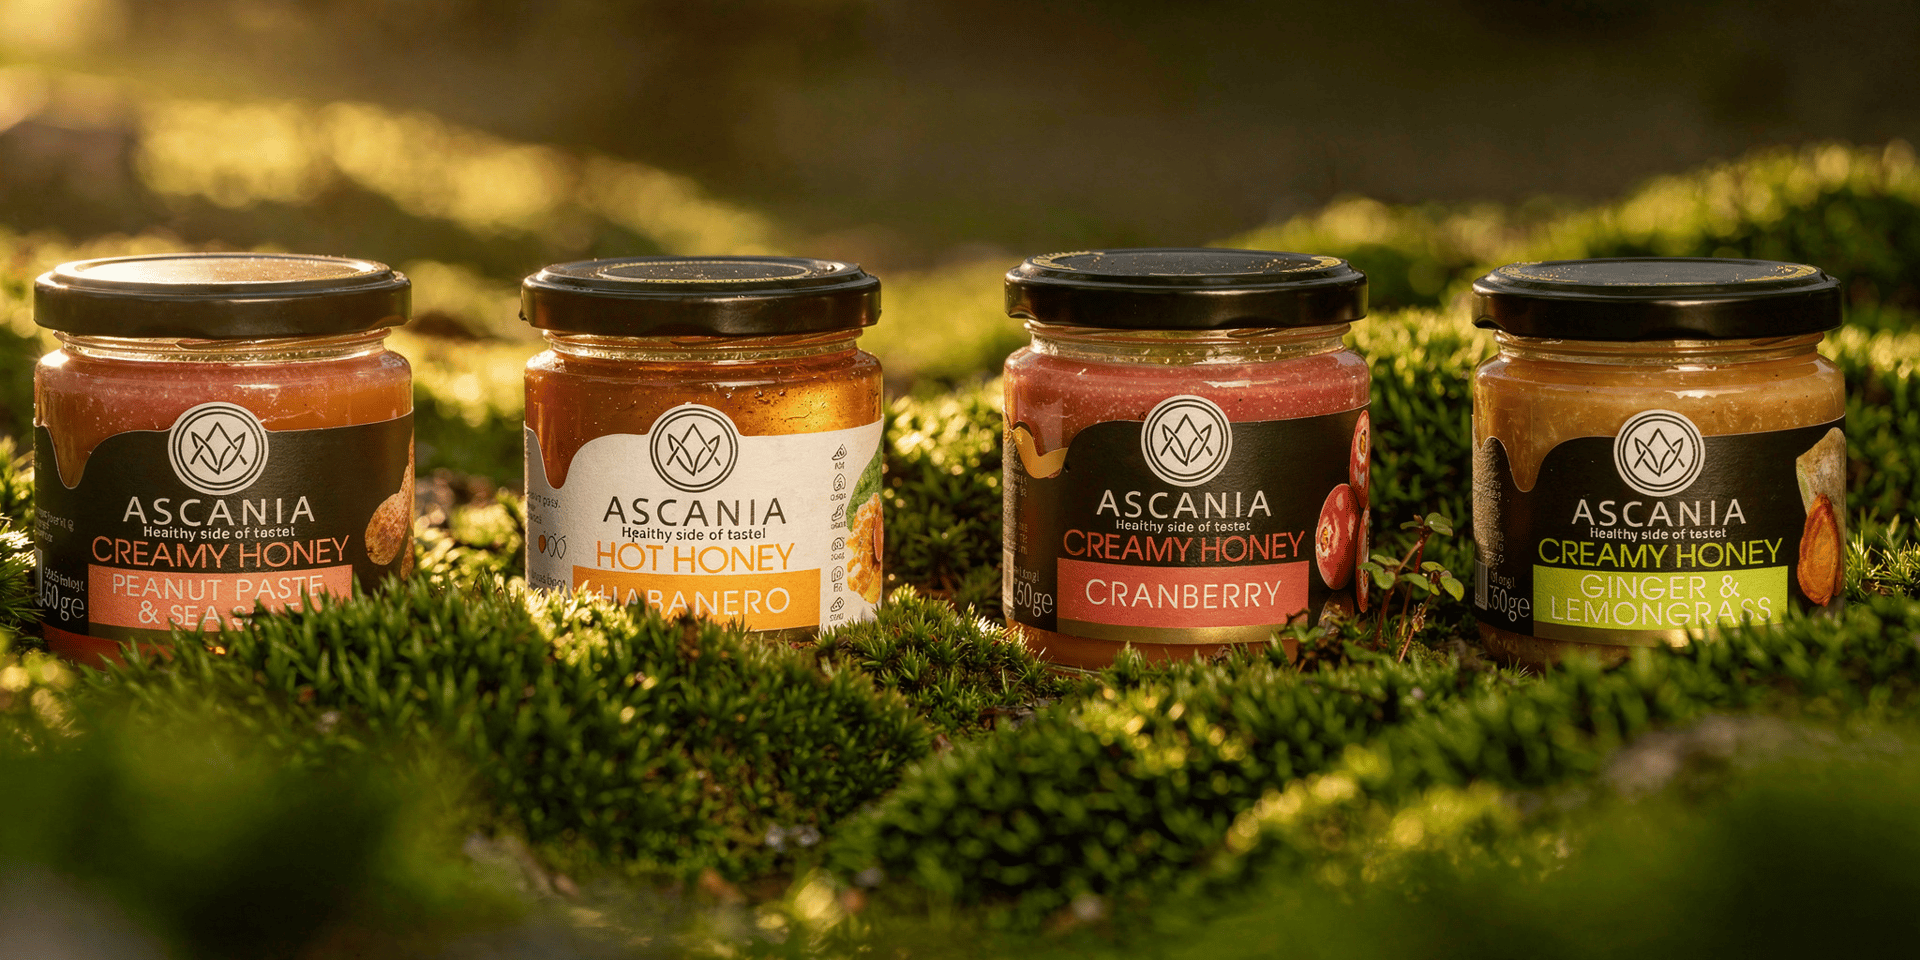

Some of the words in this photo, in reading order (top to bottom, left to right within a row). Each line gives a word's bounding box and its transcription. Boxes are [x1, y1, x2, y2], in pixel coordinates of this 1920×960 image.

[123, 496, 315, 527] ASCANIA
[603, 496, 787, 527] ASCANIA
[1096, 489, 1272, 519] ASCANIA
[1571, 498, 1747, 527] ASCANIA
[200, 527, 230, 540] side
[234, 527, 251, 540] of
[676, 528, 704, 541] side
[709, 528, 724, 541] of
[1167, 520, 1194, 533] side
[1198, 520, 1211, 533] of
[1672, 528, 1686, 540] of
[92, 535, 230, 568] CREAMY
[239, 535, 349, 568] HONEY
[596, 540, 664, 571] HOT
[673, 542, 795, 573] HONEY
[1063, 529, 1193, 562] CREAMY
[1201, 530, 1305, 562] HONEY
[1538, 538, 1669, 568] CREAMY
[1676, 537, 1783, 568] HONEY
[112, 573, 222, 600] PEANUT
[236, 574, 323, 600] PASTE
[1086, 578, 1281, 609] CRANBERRY
[1580, 573, 1706, 600] GINGER
[1719, 574, 1740, 598] &
[138, 600, 161, 624] &
[170, 605, 222, 627] SEA
[1551, 595, 1772, 625] LEMONGRASS
